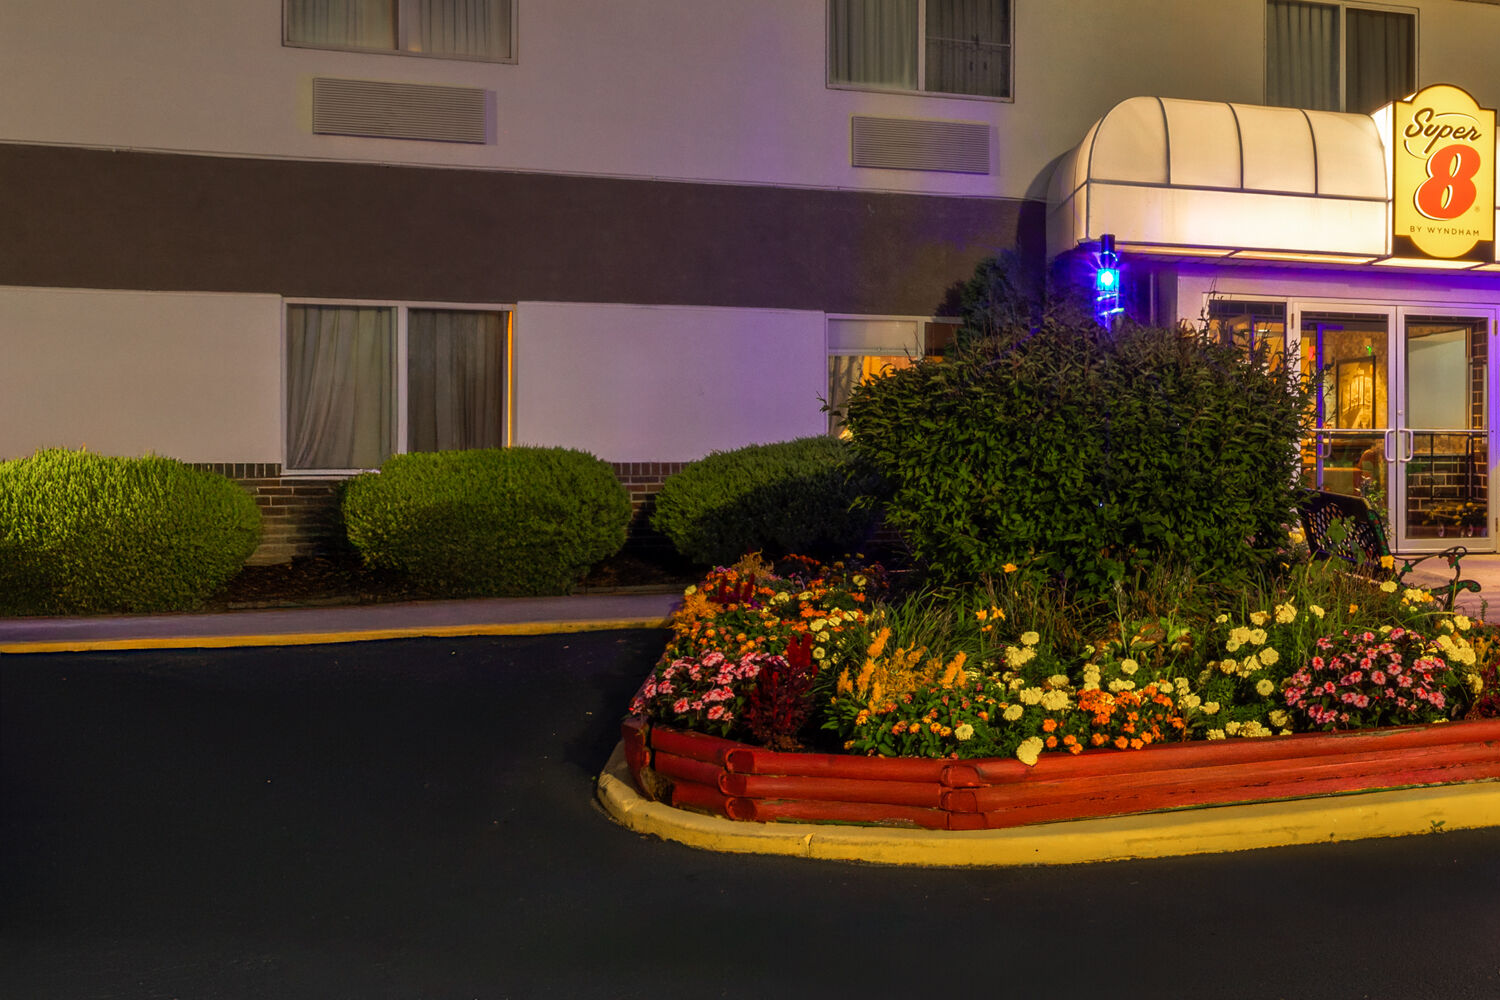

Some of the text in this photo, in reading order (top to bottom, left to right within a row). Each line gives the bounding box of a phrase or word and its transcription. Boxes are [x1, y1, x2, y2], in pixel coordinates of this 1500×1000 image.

[1404, 107, 1482, 154] Super
[1413, 144, 1481, 221] 8
[1409, 225, 1480, 237] BY WYNDHAM
